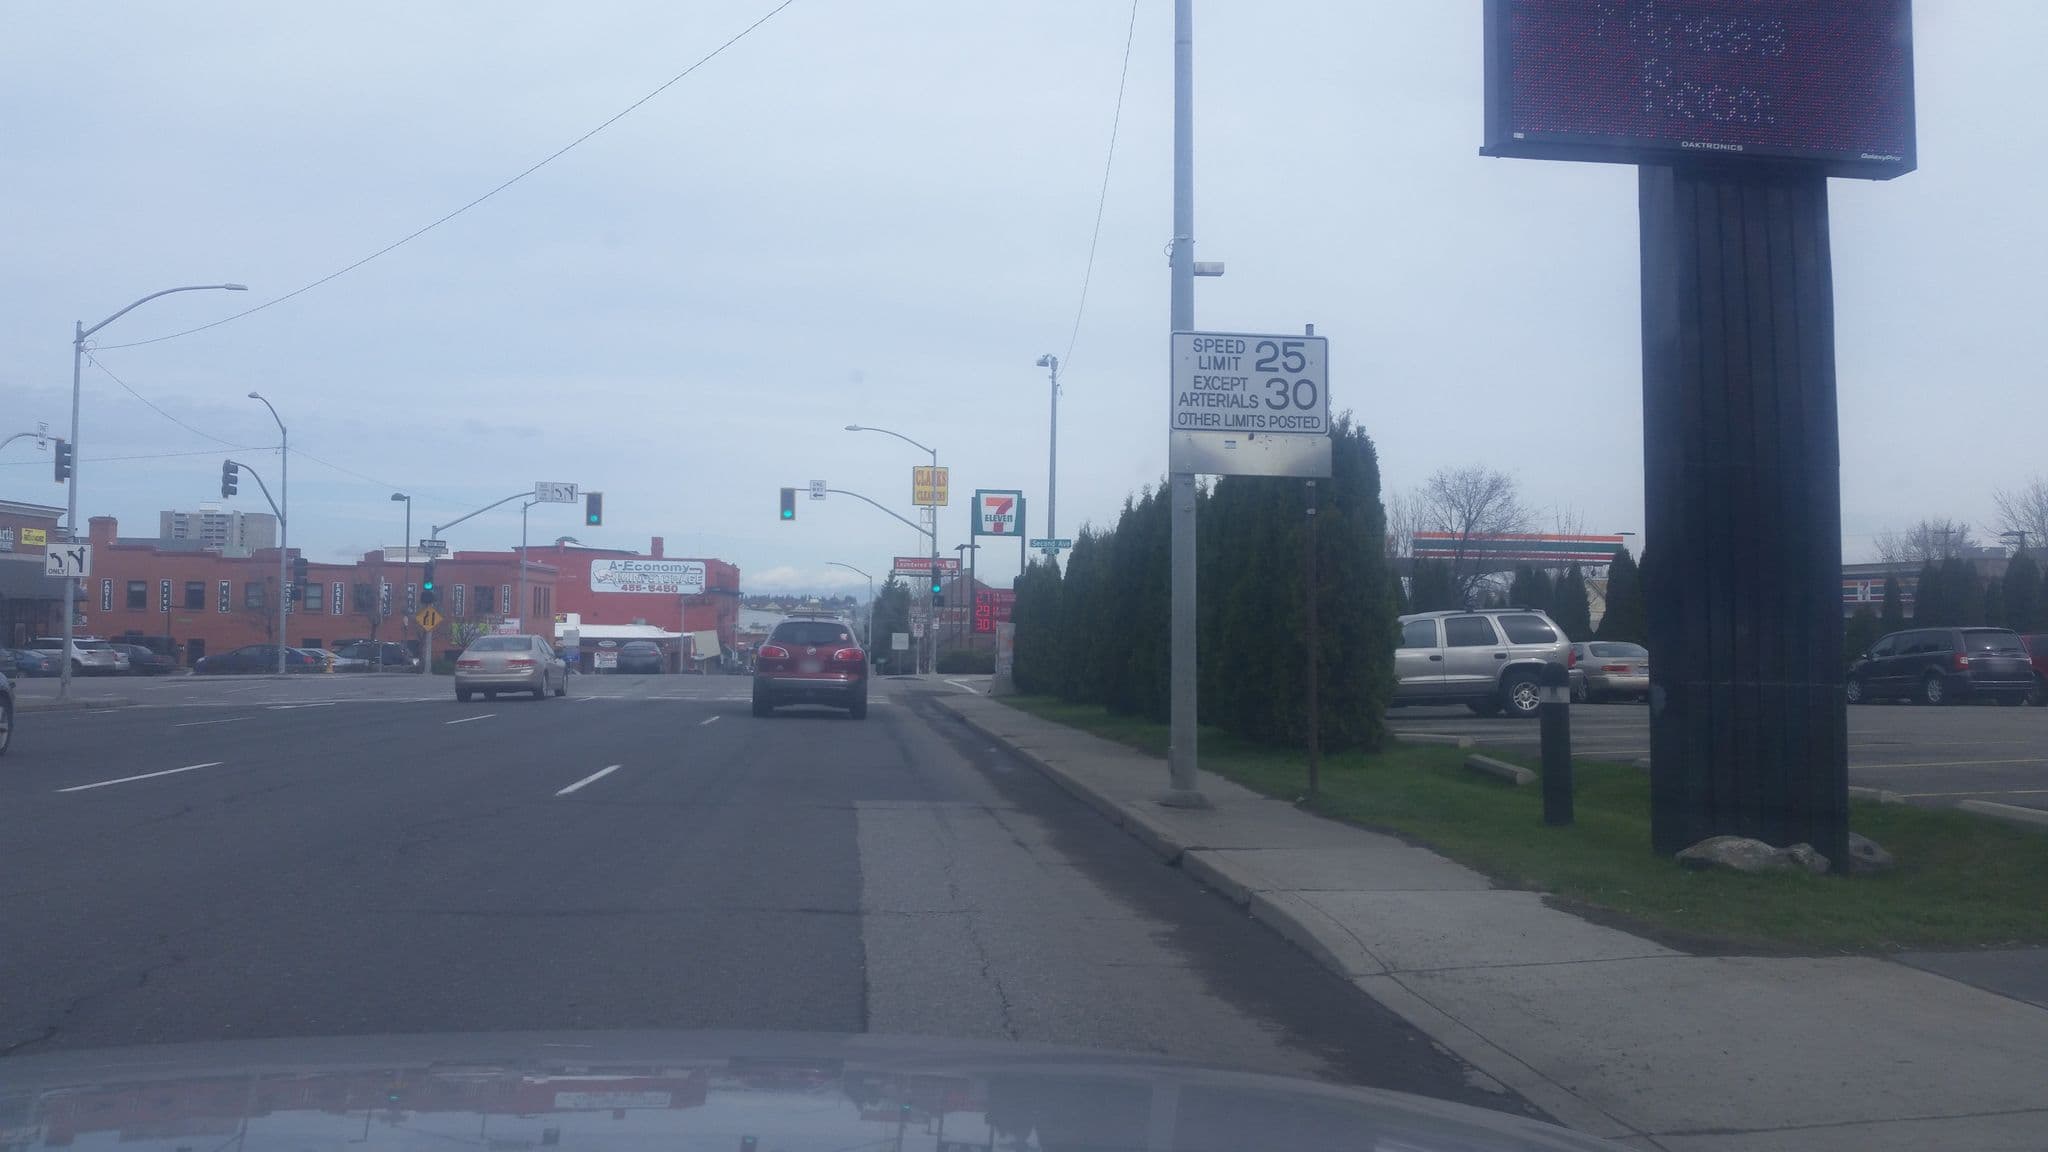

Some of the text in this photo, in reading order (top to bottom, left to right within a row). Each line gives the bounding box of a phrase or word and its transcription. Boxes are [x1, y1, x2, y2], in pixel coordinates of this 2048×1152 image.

[1681, 140, 1744, 152] DAKTRONICS
[1193, 338, 1306, 373] SPEED 25
[1199, 356, 1241, 371] LIMIT
[1178, 392, 1259, 409] ARTERIALS
[1193, 375, 1318, 410] EXCEPT 30
[1178, 412, 1321, 429] OTHER LIMITS POSTED
[985, 497, 1013, 532] 7
[608, 560, 691, 573] A-Economy
